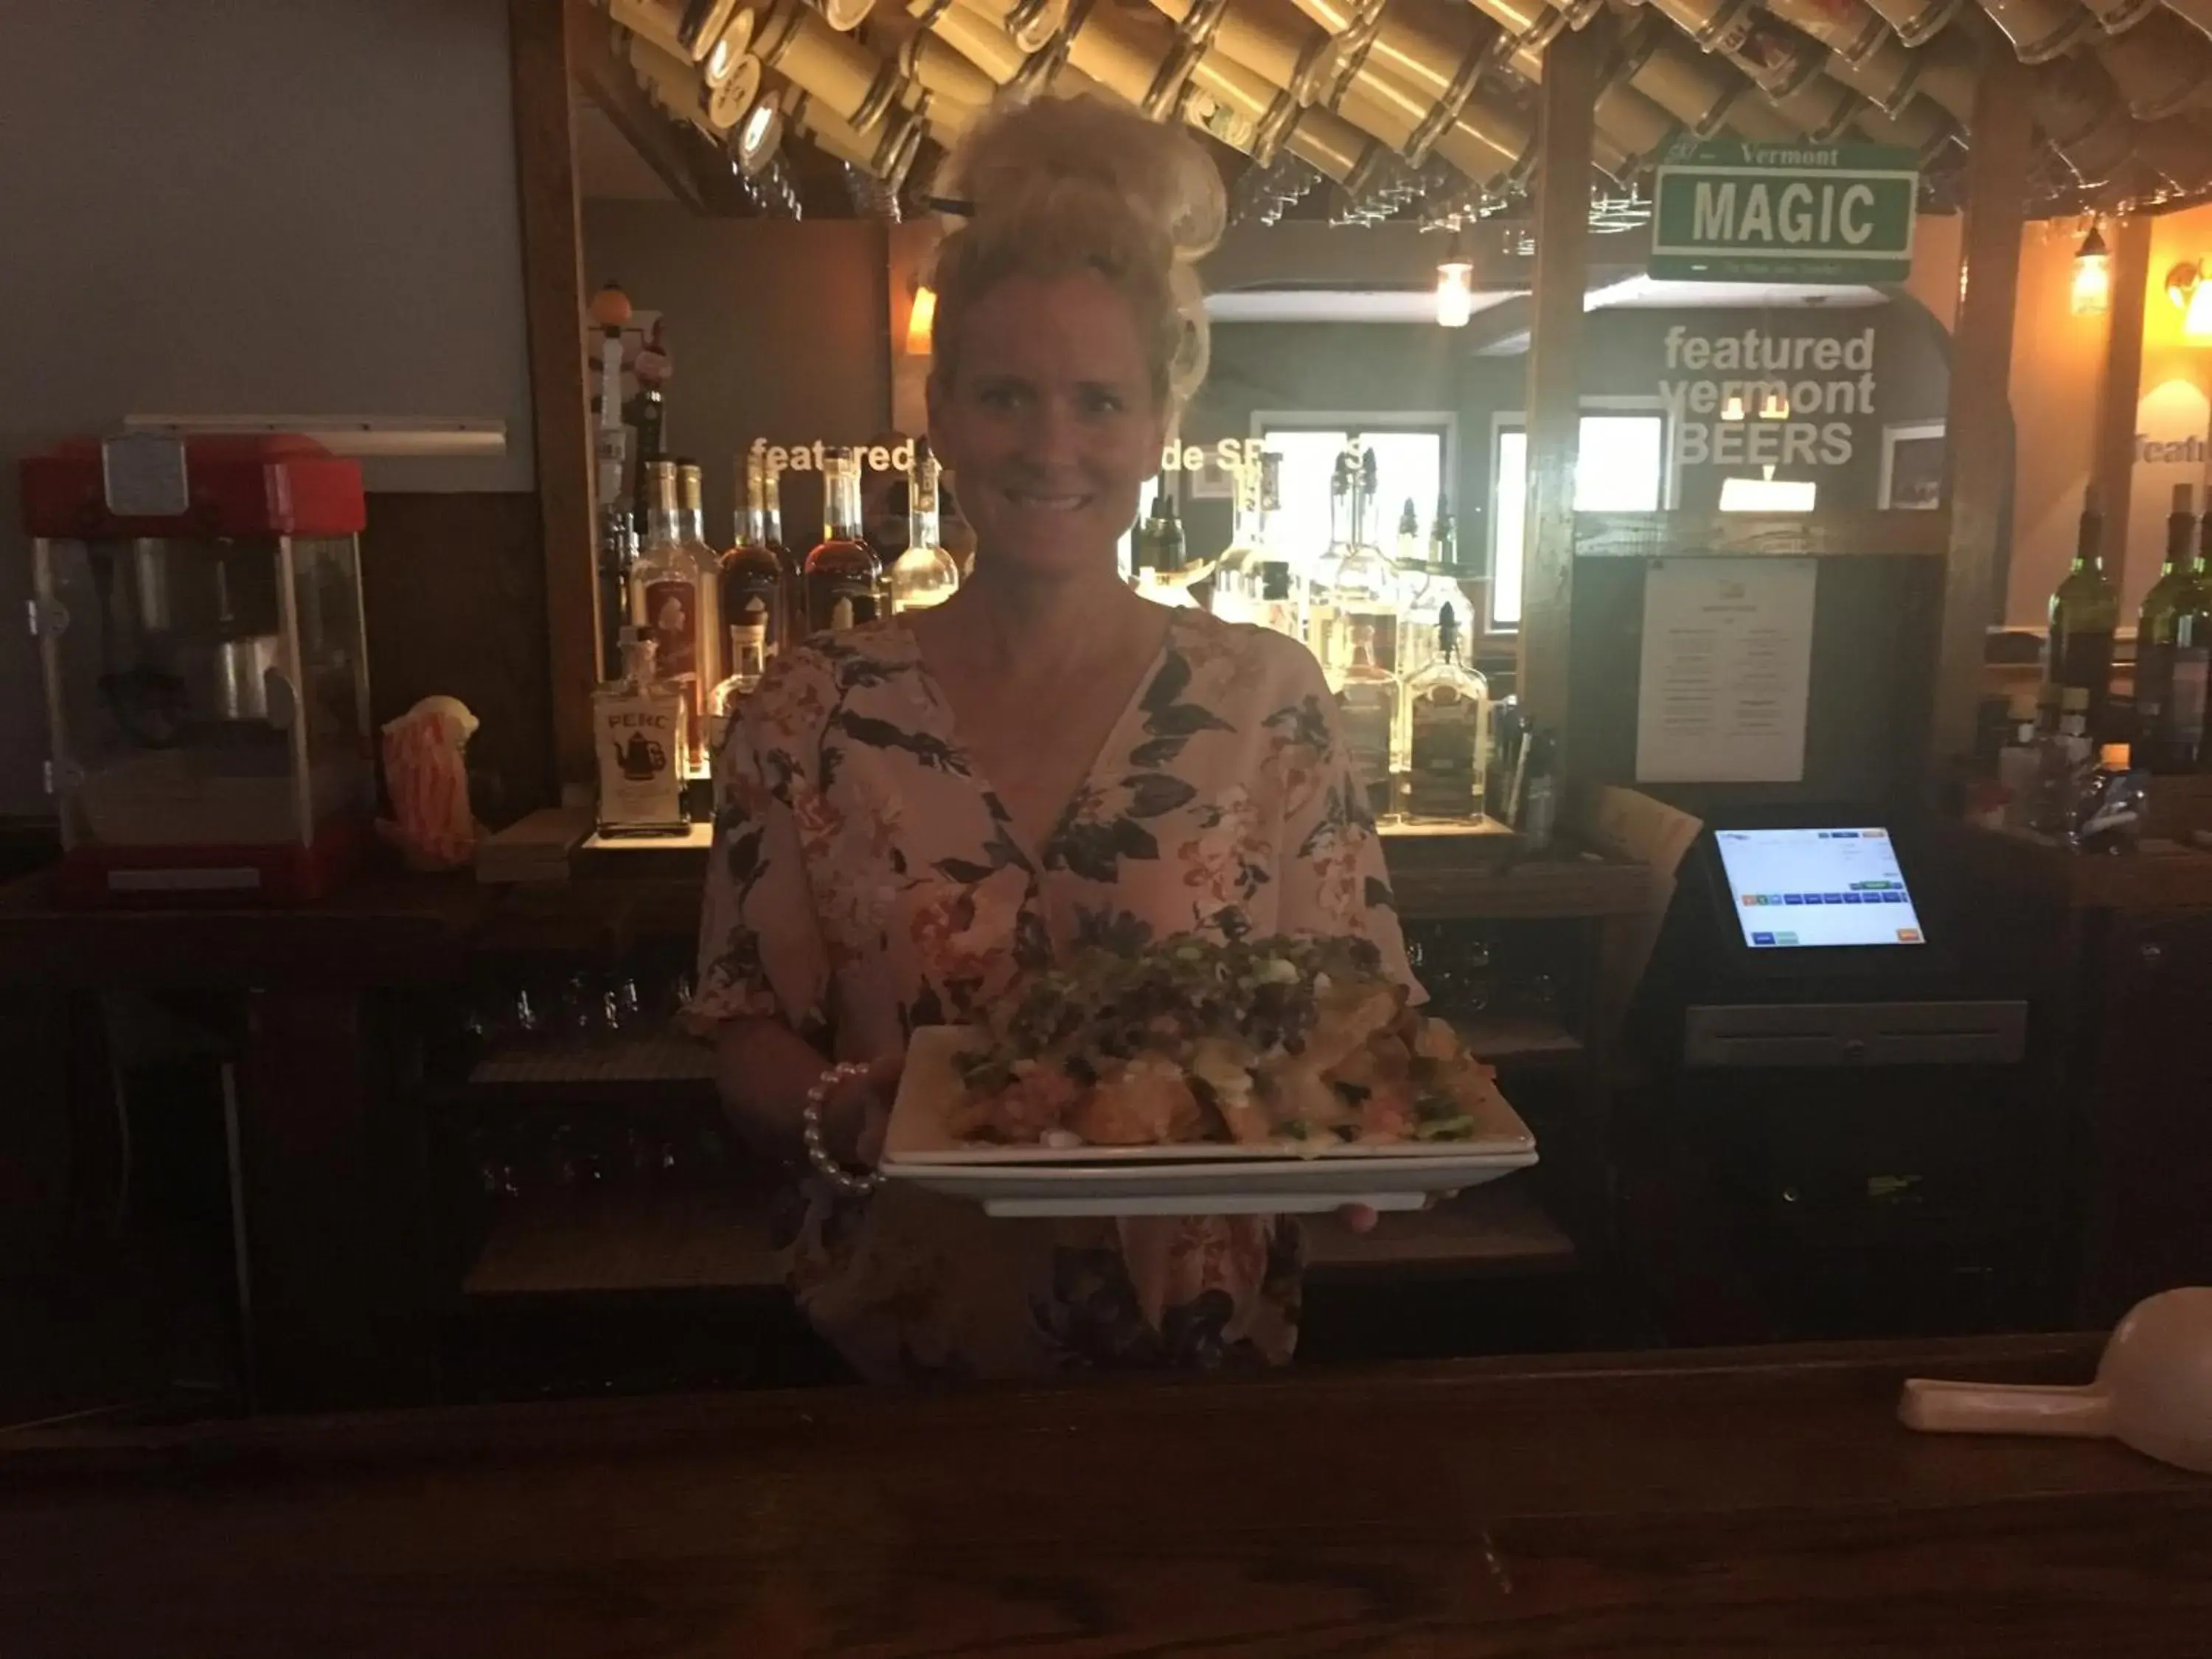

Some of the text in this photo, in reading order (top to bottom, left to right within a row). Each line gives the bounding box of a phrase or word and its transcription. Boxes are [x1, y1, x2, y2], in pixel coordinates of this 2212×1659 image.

[1741, 143, 1838, 167] Vermont
[1694, 181, 1875, 244] MAGIC
[1664, 327, 1874, 370] featured
[1659, 374, 1875, 415] vermont
[751, 438, 915, 470] featred
[1674, 422, 1853, 465] BEERS
